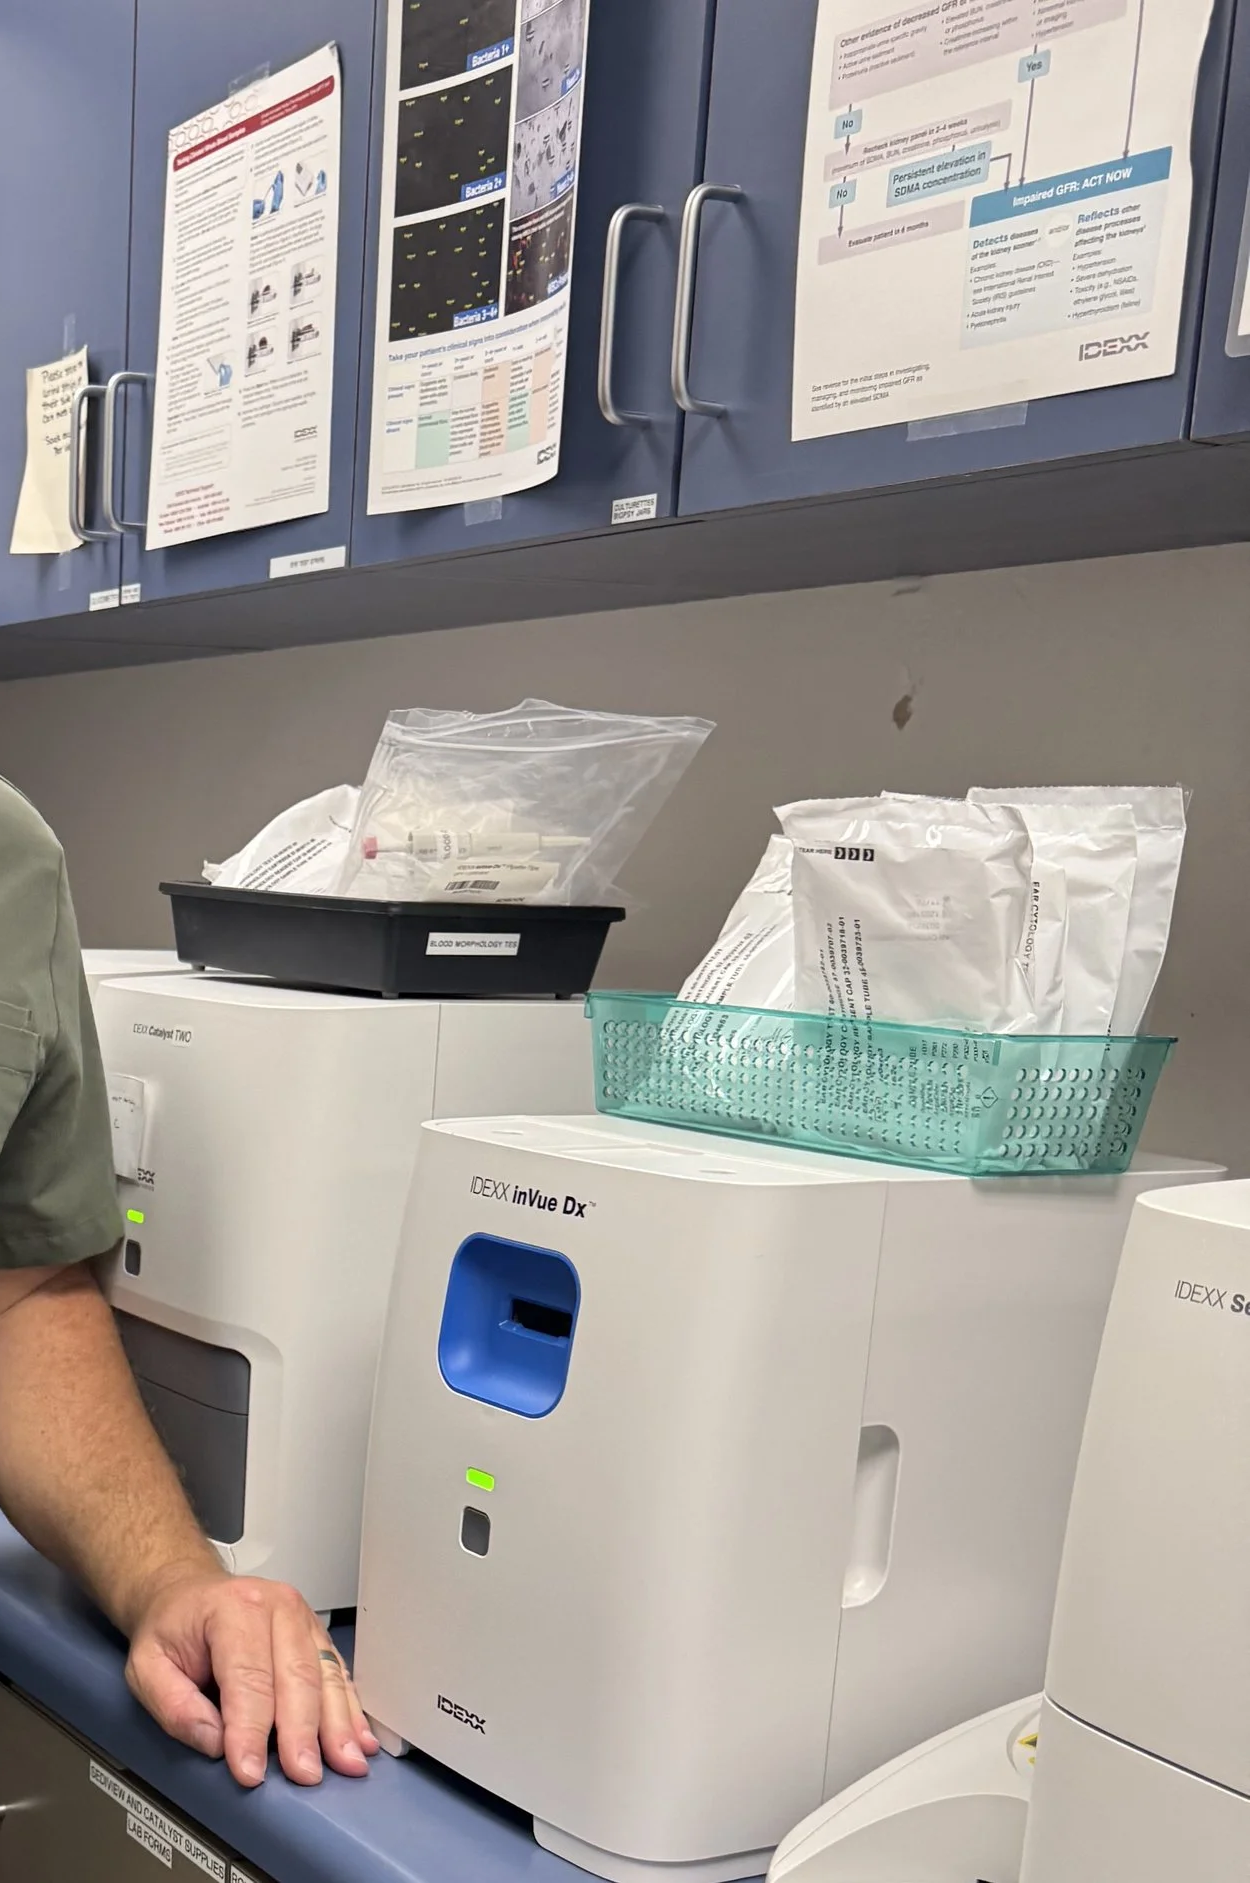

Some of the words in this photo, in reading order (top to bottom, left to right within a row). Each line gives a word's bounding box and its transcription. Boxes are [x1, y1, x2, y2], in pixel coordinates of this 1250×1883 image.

[1026, 61, 1043, 72] Yes
[842, 120, 854, 130] No
[892, 165, 935, 185] Persistent
[936, 155, 976, 175] elevation
[977, 151, 986, 161] in
[894, 182, 920, 198] SDMA
[922, 166, 981, 192] concentration
[836, 189, 848, 199] No
[1012, 186, 1054, 207] Impaired
[1056, 181, 1080, 197] GFR:
[1081, 173, 1103, 189] ACT
[1105, 166, 1133, 183] NOW
[1078, 206, 1120, 224] Reflects
[973, 234, 1008, 249] Detects
[1079, 331, 1150, 361] IDEXX
[148, 1026, 174, 1040] Catalyst
[174, 1029, 192, 1043] TWO
[470, 1175, 510, 1202] IDEXX
[512, 1185, 558, 1212] inVue
[1174, 1279, 1228, 1310] IDEXX
[437, 1694, 486, 1735] IDEXX
[90, 1764, 125, 1801] SEDIVIEW
[126, 1794, 143, 1815] AND
[143, 1807, 184, 1846] CATALYST
[184, 1838, 225, 1880] SUPPLIES
[127, 1818, 143, 1839] LAB
[143, 1831, 172, 1863] FORMS
